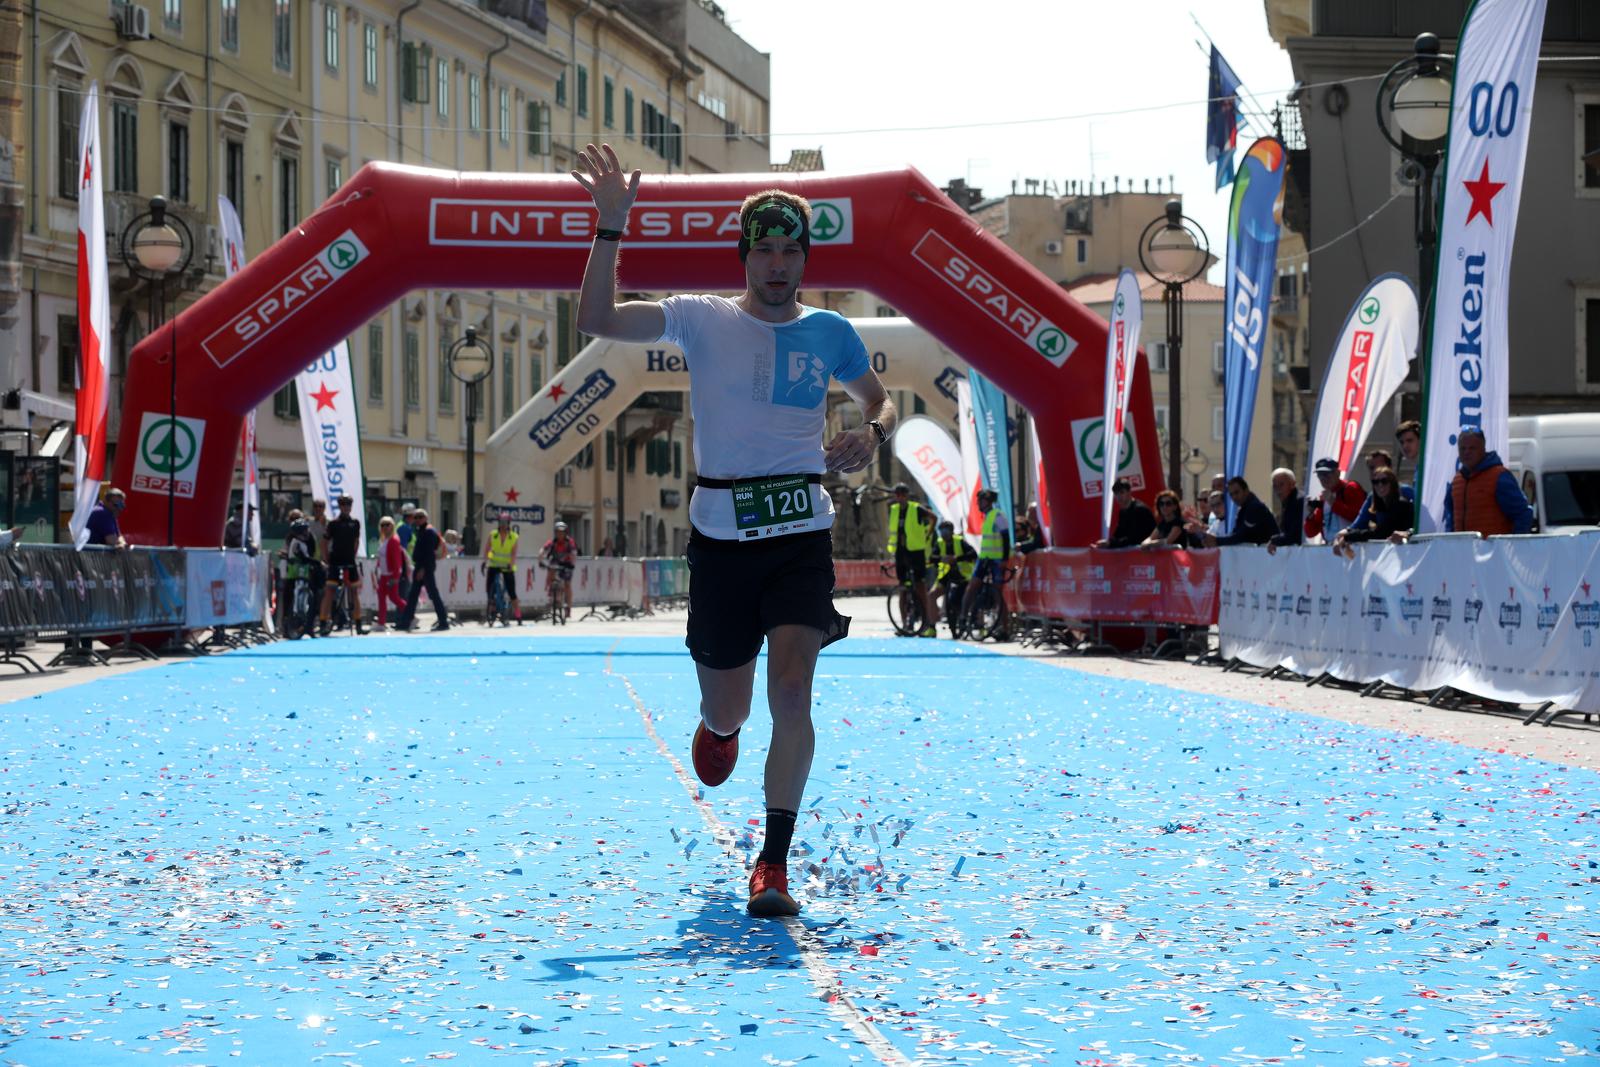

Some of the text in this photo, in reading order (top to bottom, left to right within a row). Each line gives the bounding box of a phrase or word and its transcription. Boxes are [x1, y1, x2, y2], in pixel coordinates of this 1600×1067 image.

[234, 264, 329, 341] SPAR
[943, 257, 1036, 334] SPAR
[534, 375, 610, 446] Heineken
[1343, 333, 1371, 442] SPAR
[736, 491, 753, 501] RUN
[764, 488, 808, 517] 120
